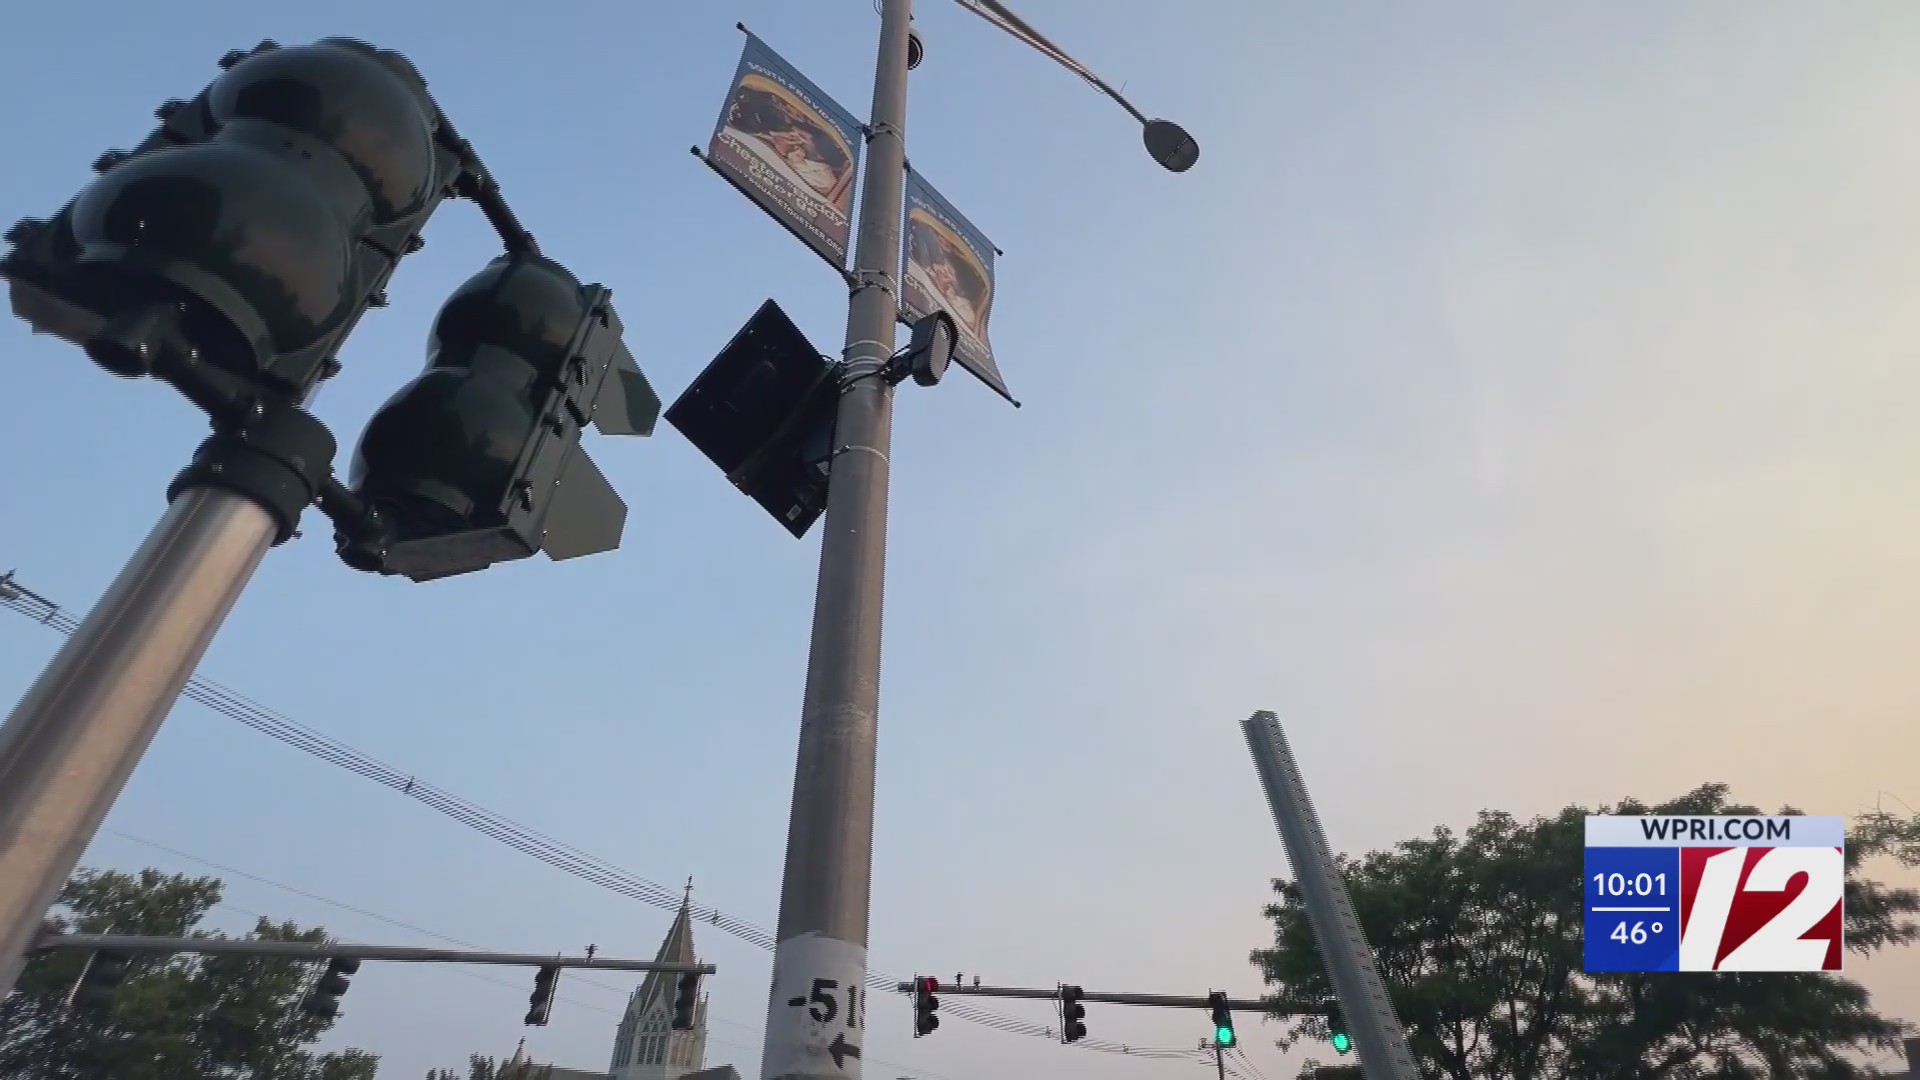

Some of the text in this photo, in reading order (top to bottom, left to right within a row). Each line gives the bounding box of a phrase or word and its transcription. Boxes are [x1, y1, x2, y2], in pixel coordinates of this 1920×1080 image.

[747, 61, 786, 86] SOUTH
[717, 132, 784, 184] Chester
[749, 164, 819, 219] George
